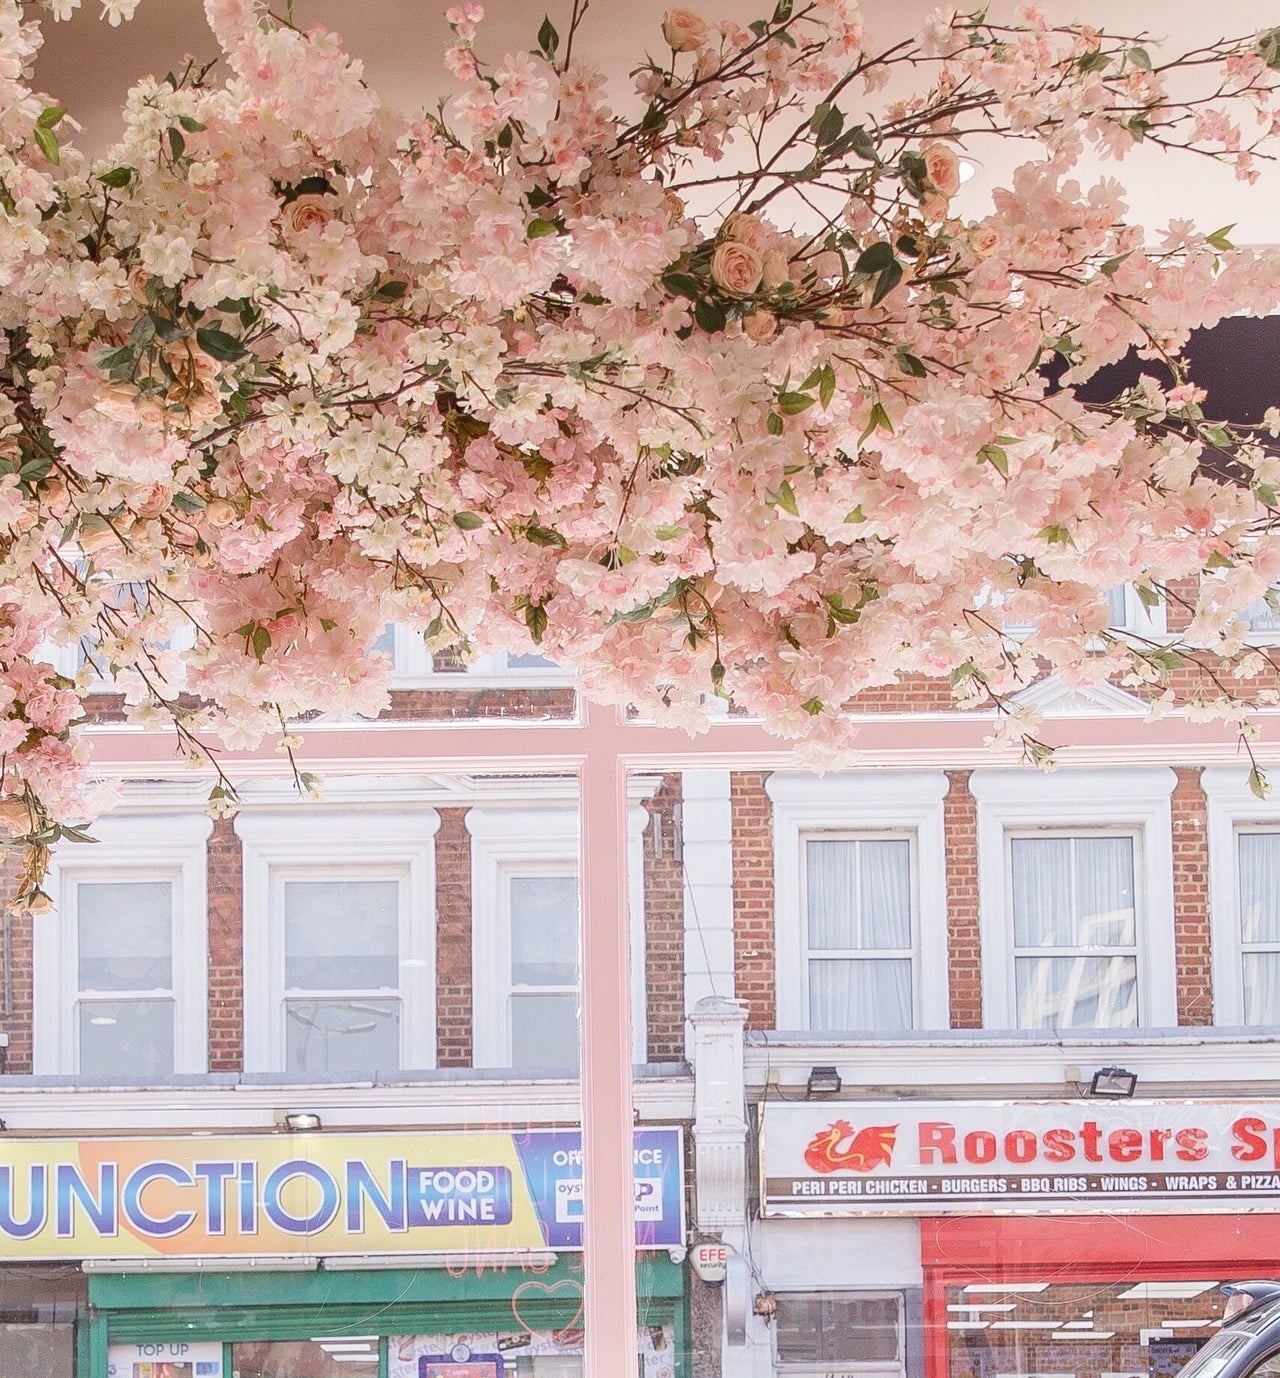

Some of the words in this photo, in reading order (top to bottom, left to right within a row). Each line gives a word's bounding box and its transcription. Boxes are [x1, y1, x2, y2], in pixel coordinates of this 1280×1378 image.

[918, 1121, 1210, 1165] Roosters
[419, 1171, 495, 1195] FOOD
[792, 1181, 825, 1195] PERI
[829, 1180, 862, 1195] PERI
[866, 1179, 928, 1195] CHICKEN
[941, 1178, 1007, 1193] BURGERS
[1021, 1177, 1051, 1193] BBQ
[1054, 1177, 1088, 1193] RIBS
[1101, 1176, 1148, 1191] WINGS
[1166, 1175, 1218, 1190] WRAPS
[1225, 1174, 1237, 1190] &
[419, 1197, 496, 1222] WINE
[136, 1343, 165, 1357] TOP
[170, 1343, 189, 1357] UP
